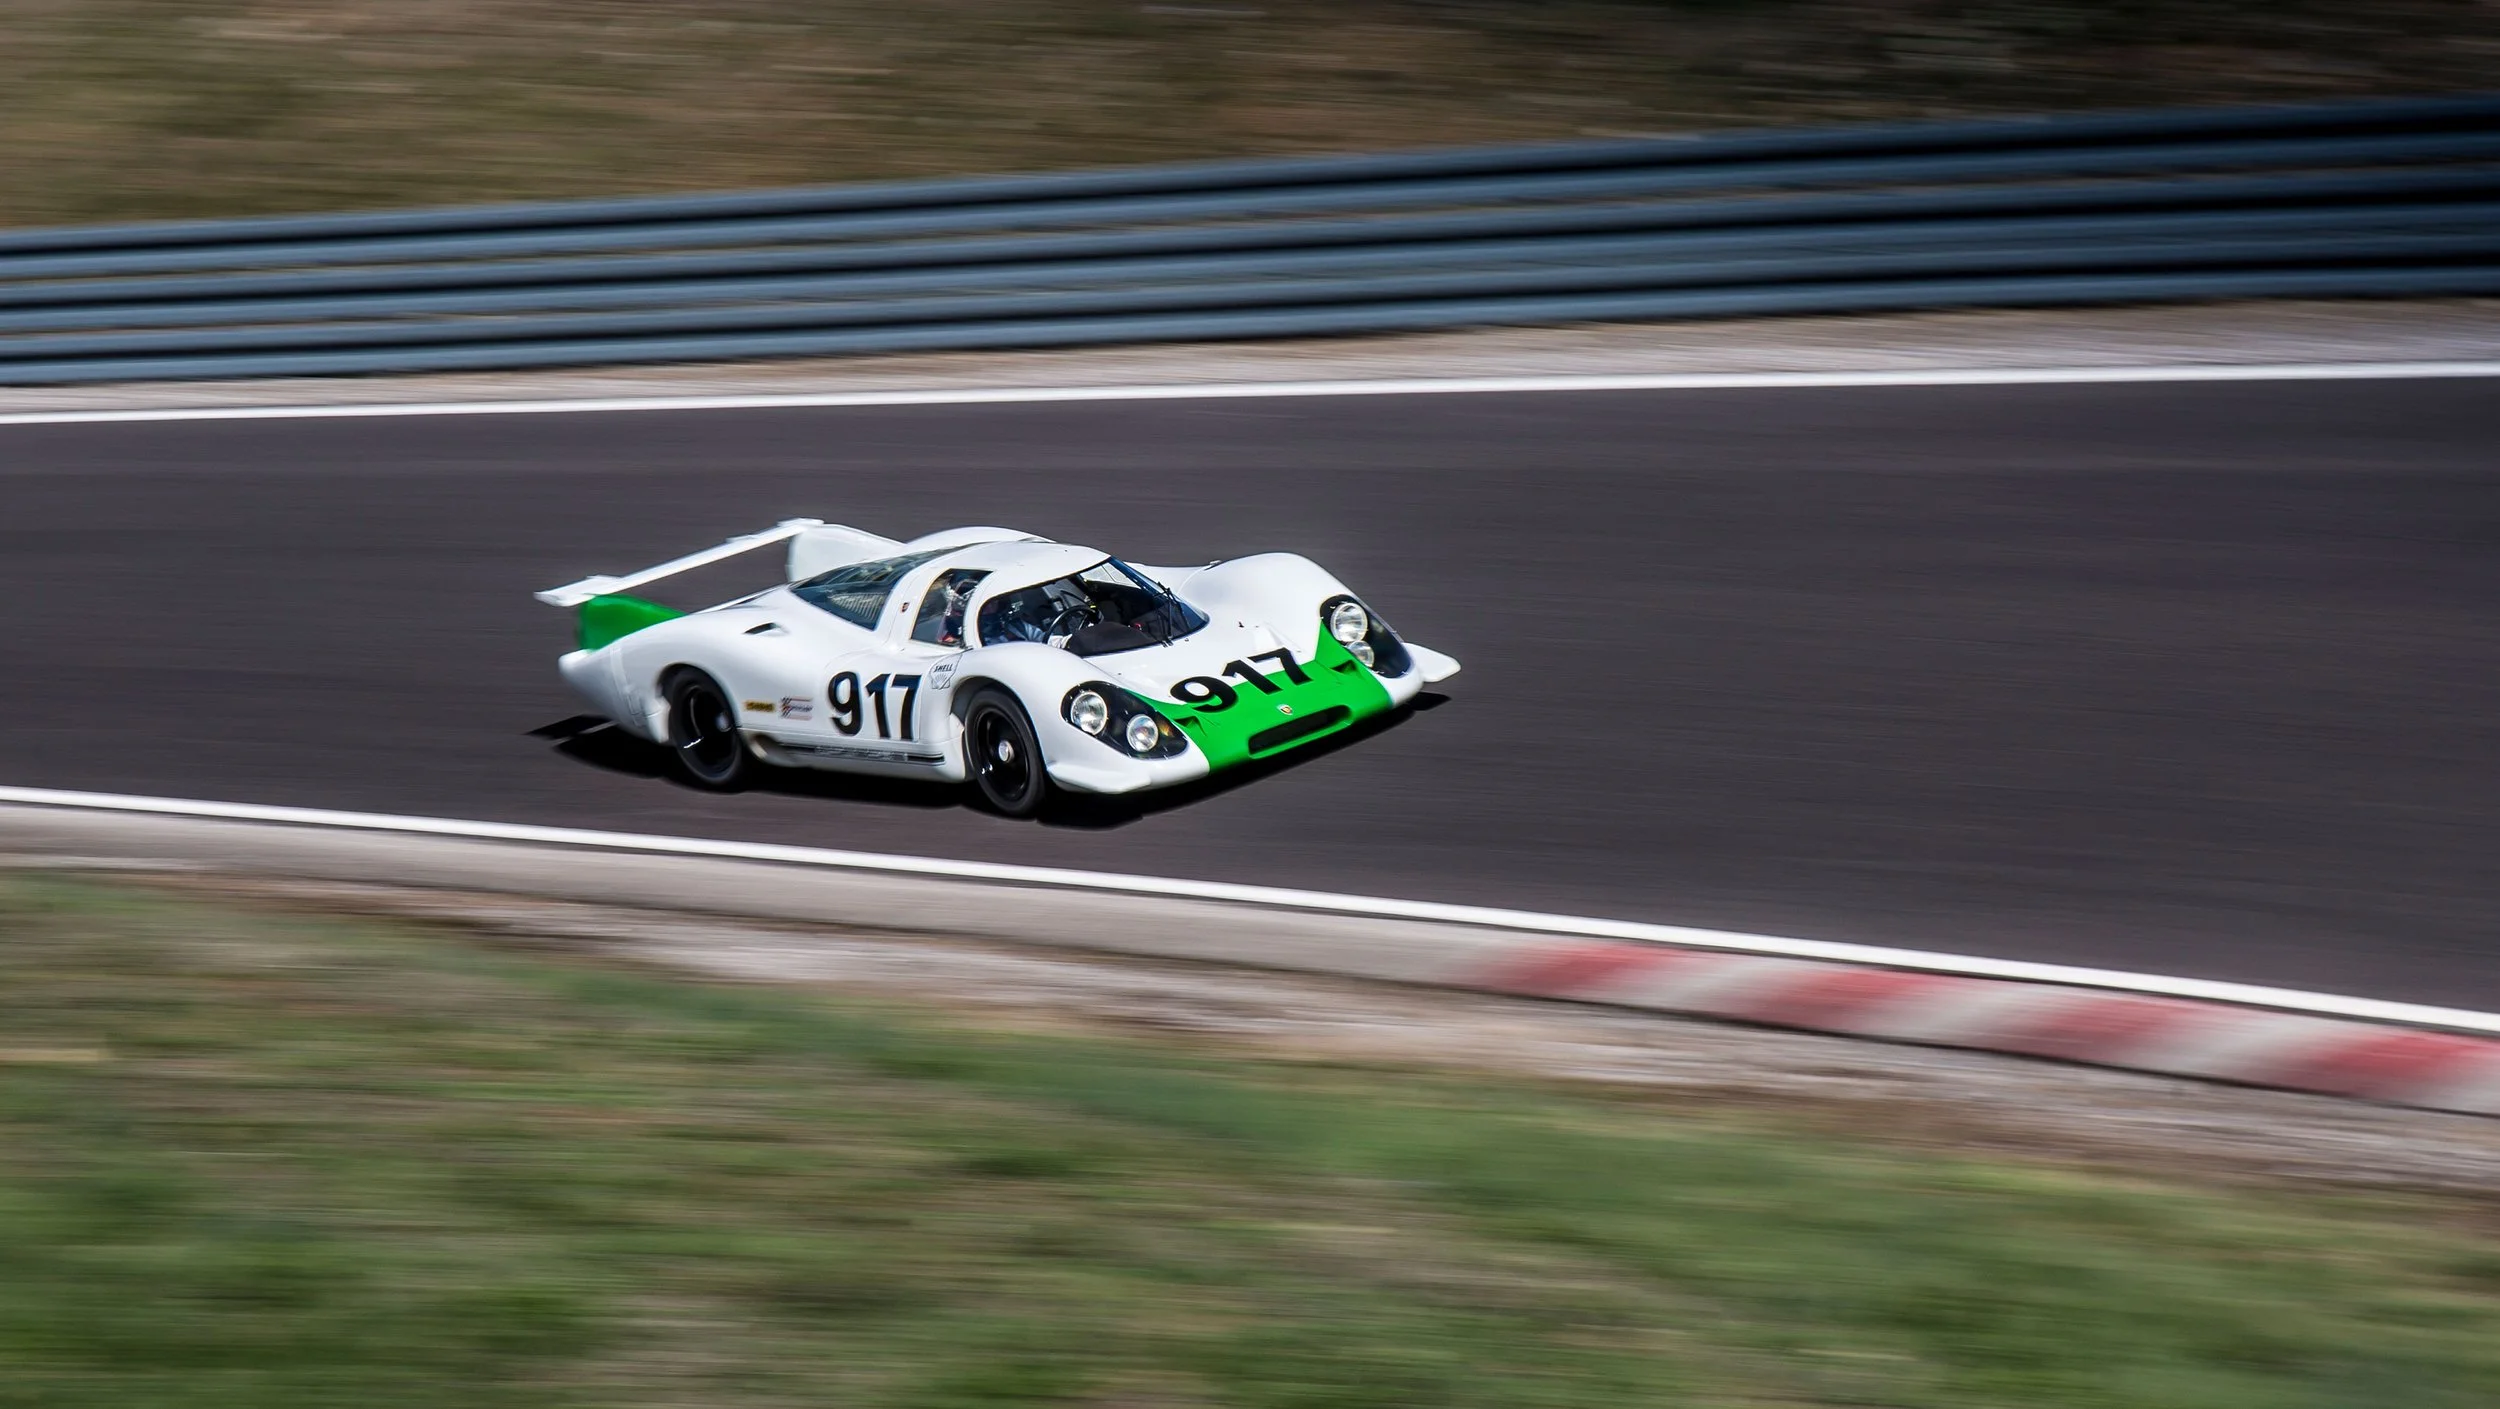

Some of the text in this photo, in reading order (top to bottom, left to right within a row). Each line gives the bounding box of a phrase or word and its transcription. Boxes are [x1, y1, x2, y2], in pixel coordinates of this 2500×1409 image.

[933, 663, 953, 672] SHELL
[1170, 647, 1314, 713] 917
[828, 671, 922, 741] 917
